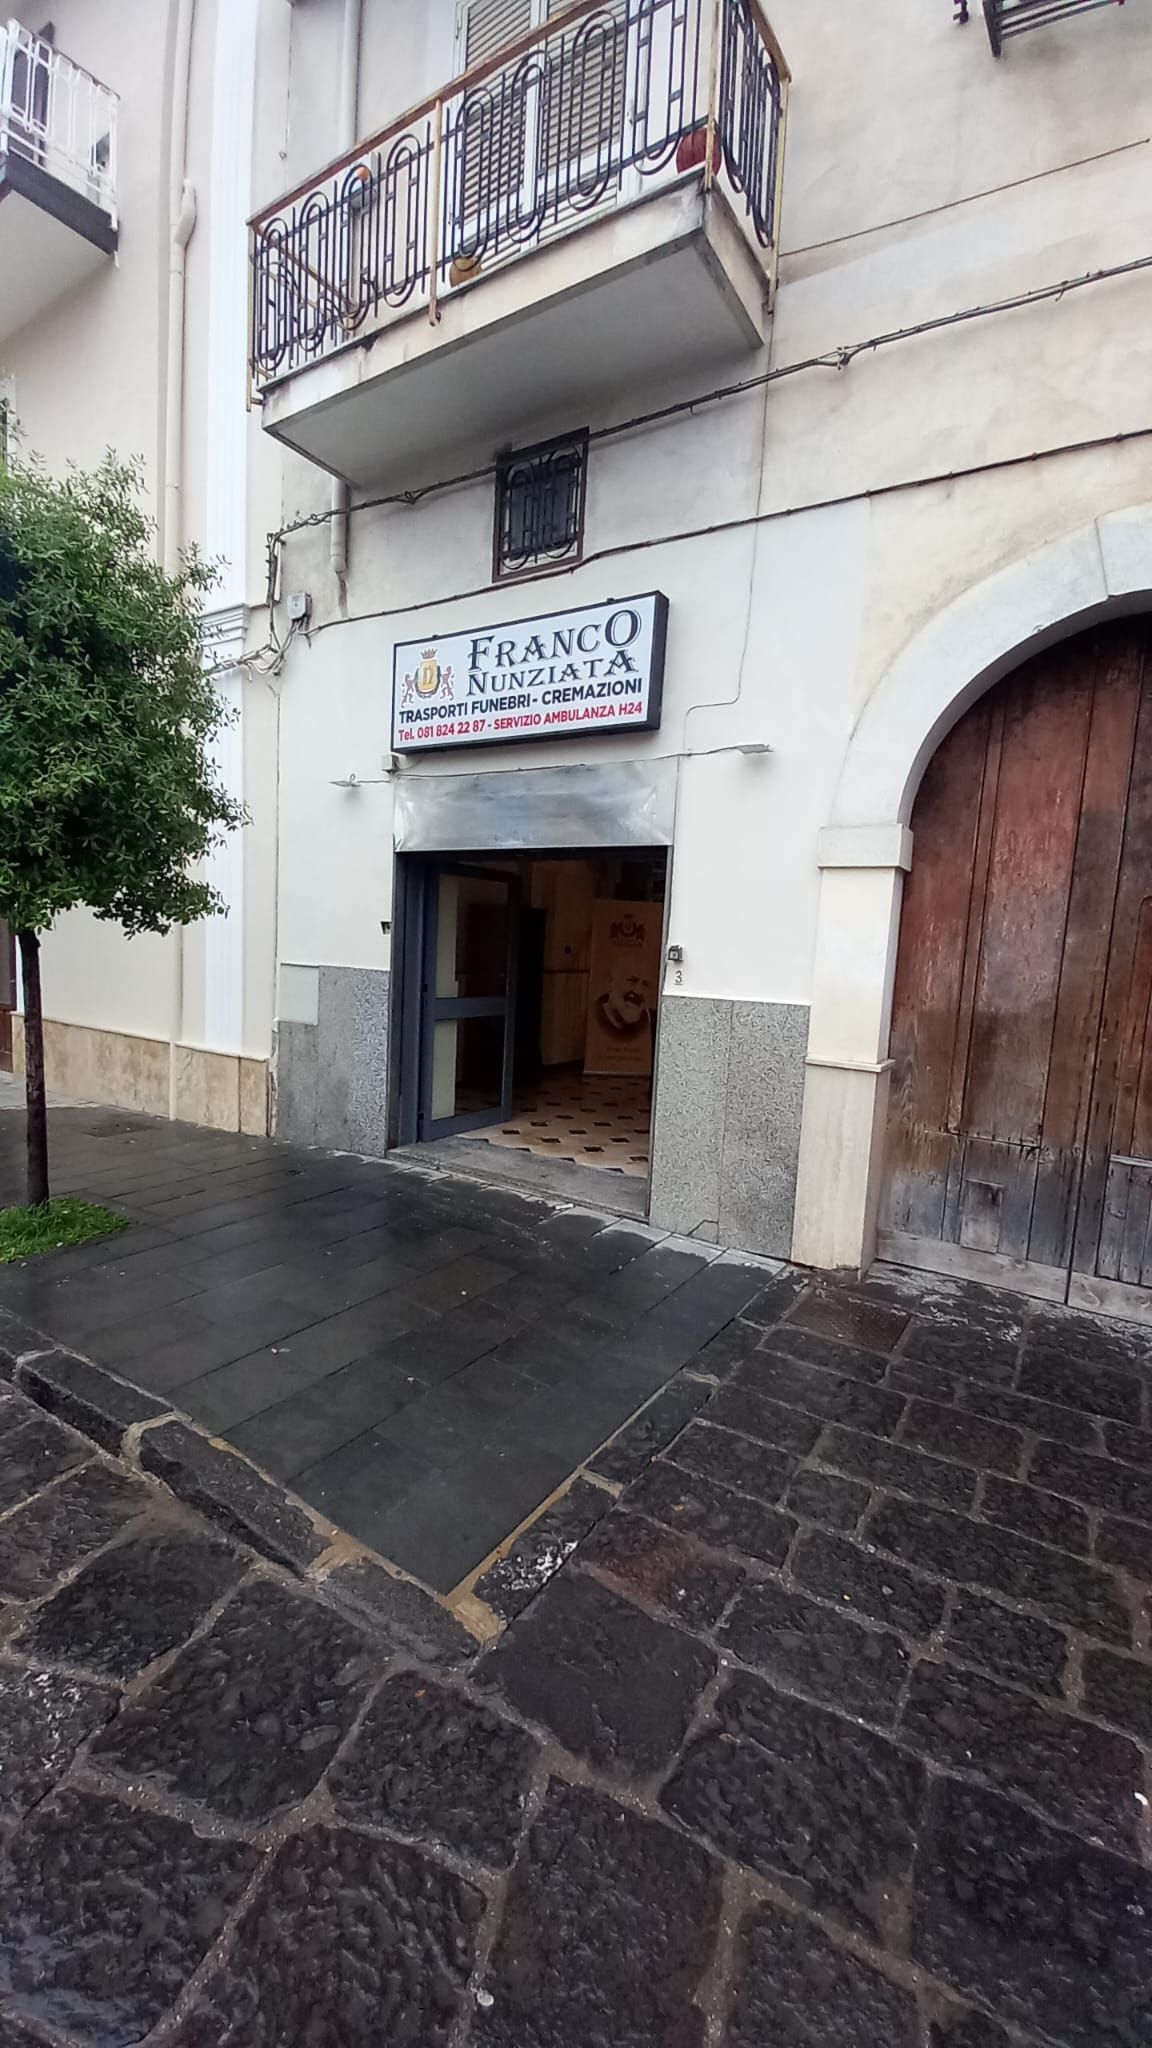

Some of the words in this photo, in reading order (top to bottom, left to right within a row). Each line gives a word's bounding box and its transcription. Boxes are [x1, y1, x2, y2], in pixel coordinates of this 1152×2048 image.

[467, 609, 641, 672] FRANCO
[466, 649, 639, 697] NUNZIATA
[398, 703, 468, 724] TRASPORTI
[471, 693, 531, 715] FUNEBRI
[541, 678, 642, 705] CREMAZIONI
[417, 725, 434, 739] 081
[436, 723, 455, 737] 824
[457, 721, 470, 735] 22
[472, 719, 487, 733] 87
[493, 713, 541, 731] SERVIZIO
[543, 704, 616, 725] AMBULANZA
[618, 701, 643, 716] H24
[675, 970, 683, 984] 3
